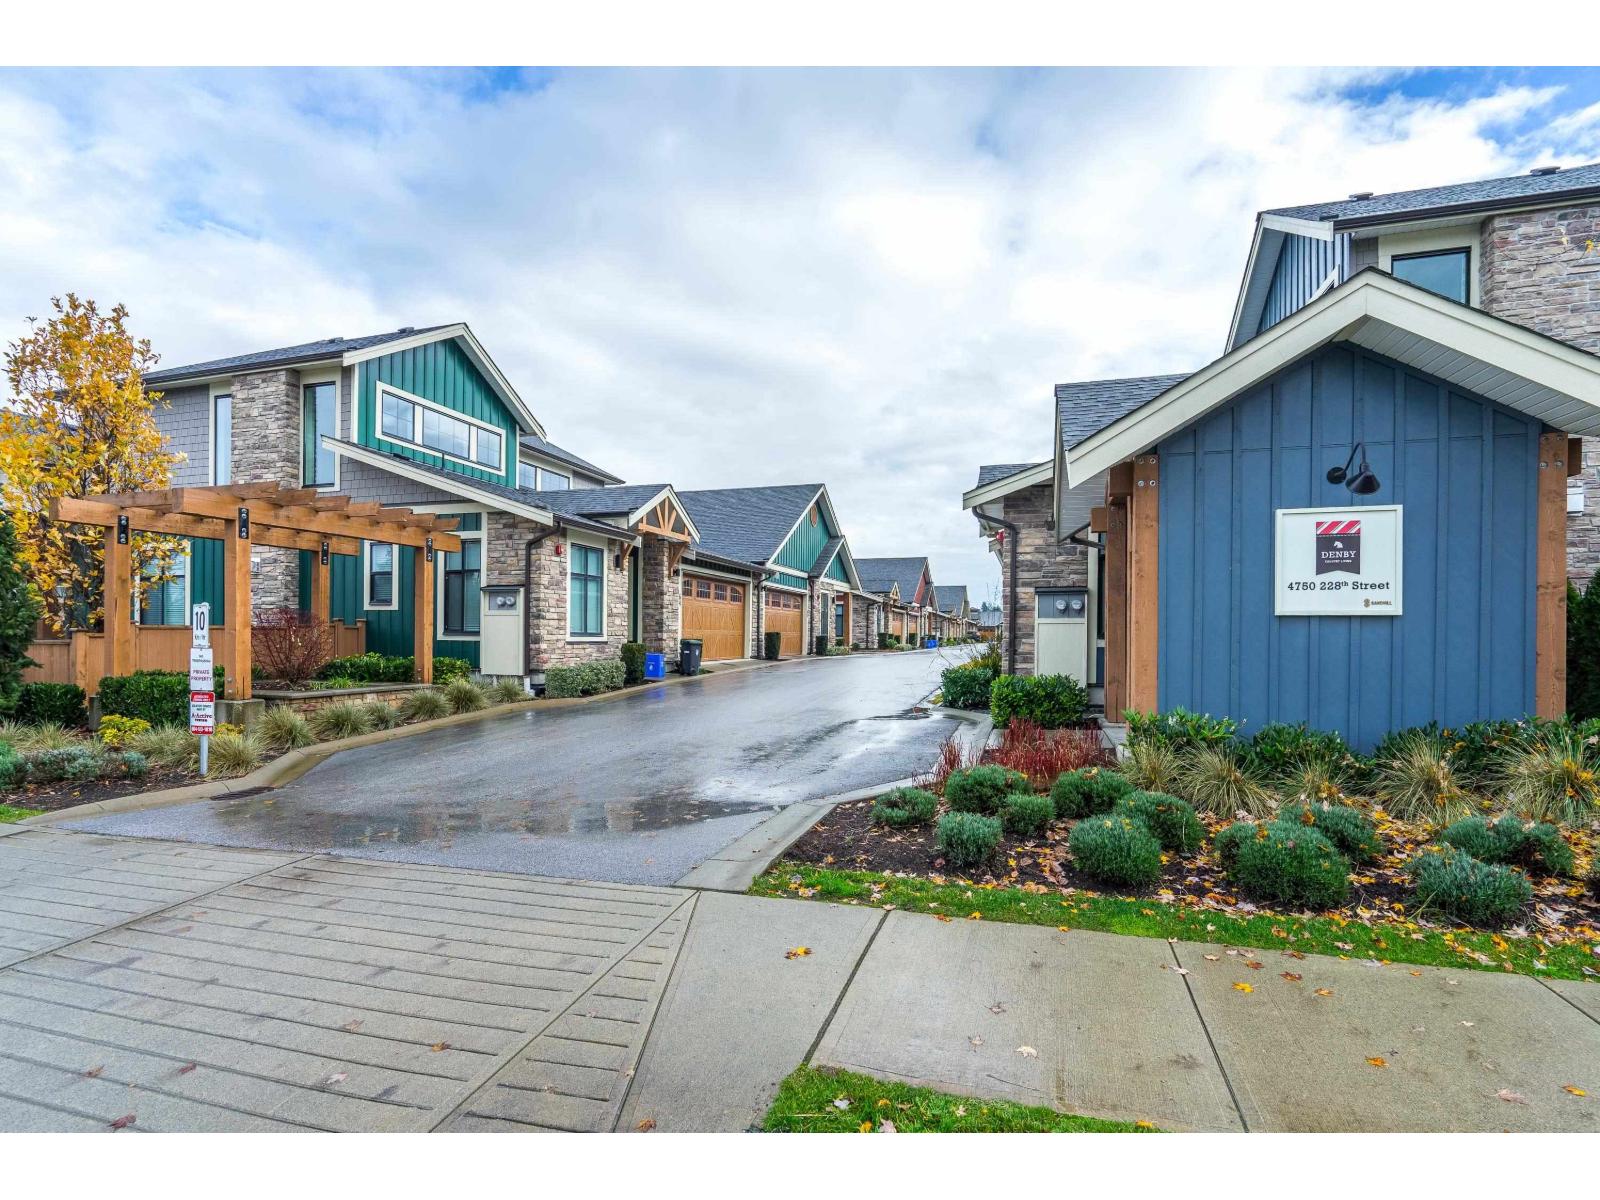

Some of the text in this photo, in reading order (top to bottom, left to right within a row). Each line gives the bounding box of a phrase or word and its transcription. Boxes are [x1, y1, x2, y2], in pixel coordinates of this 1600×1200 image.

[1320, 550, 1357, 559] DENBY
[1287, 580, 1390, 591] 4750 228th Street
[195, 611, 206, 631] 10
